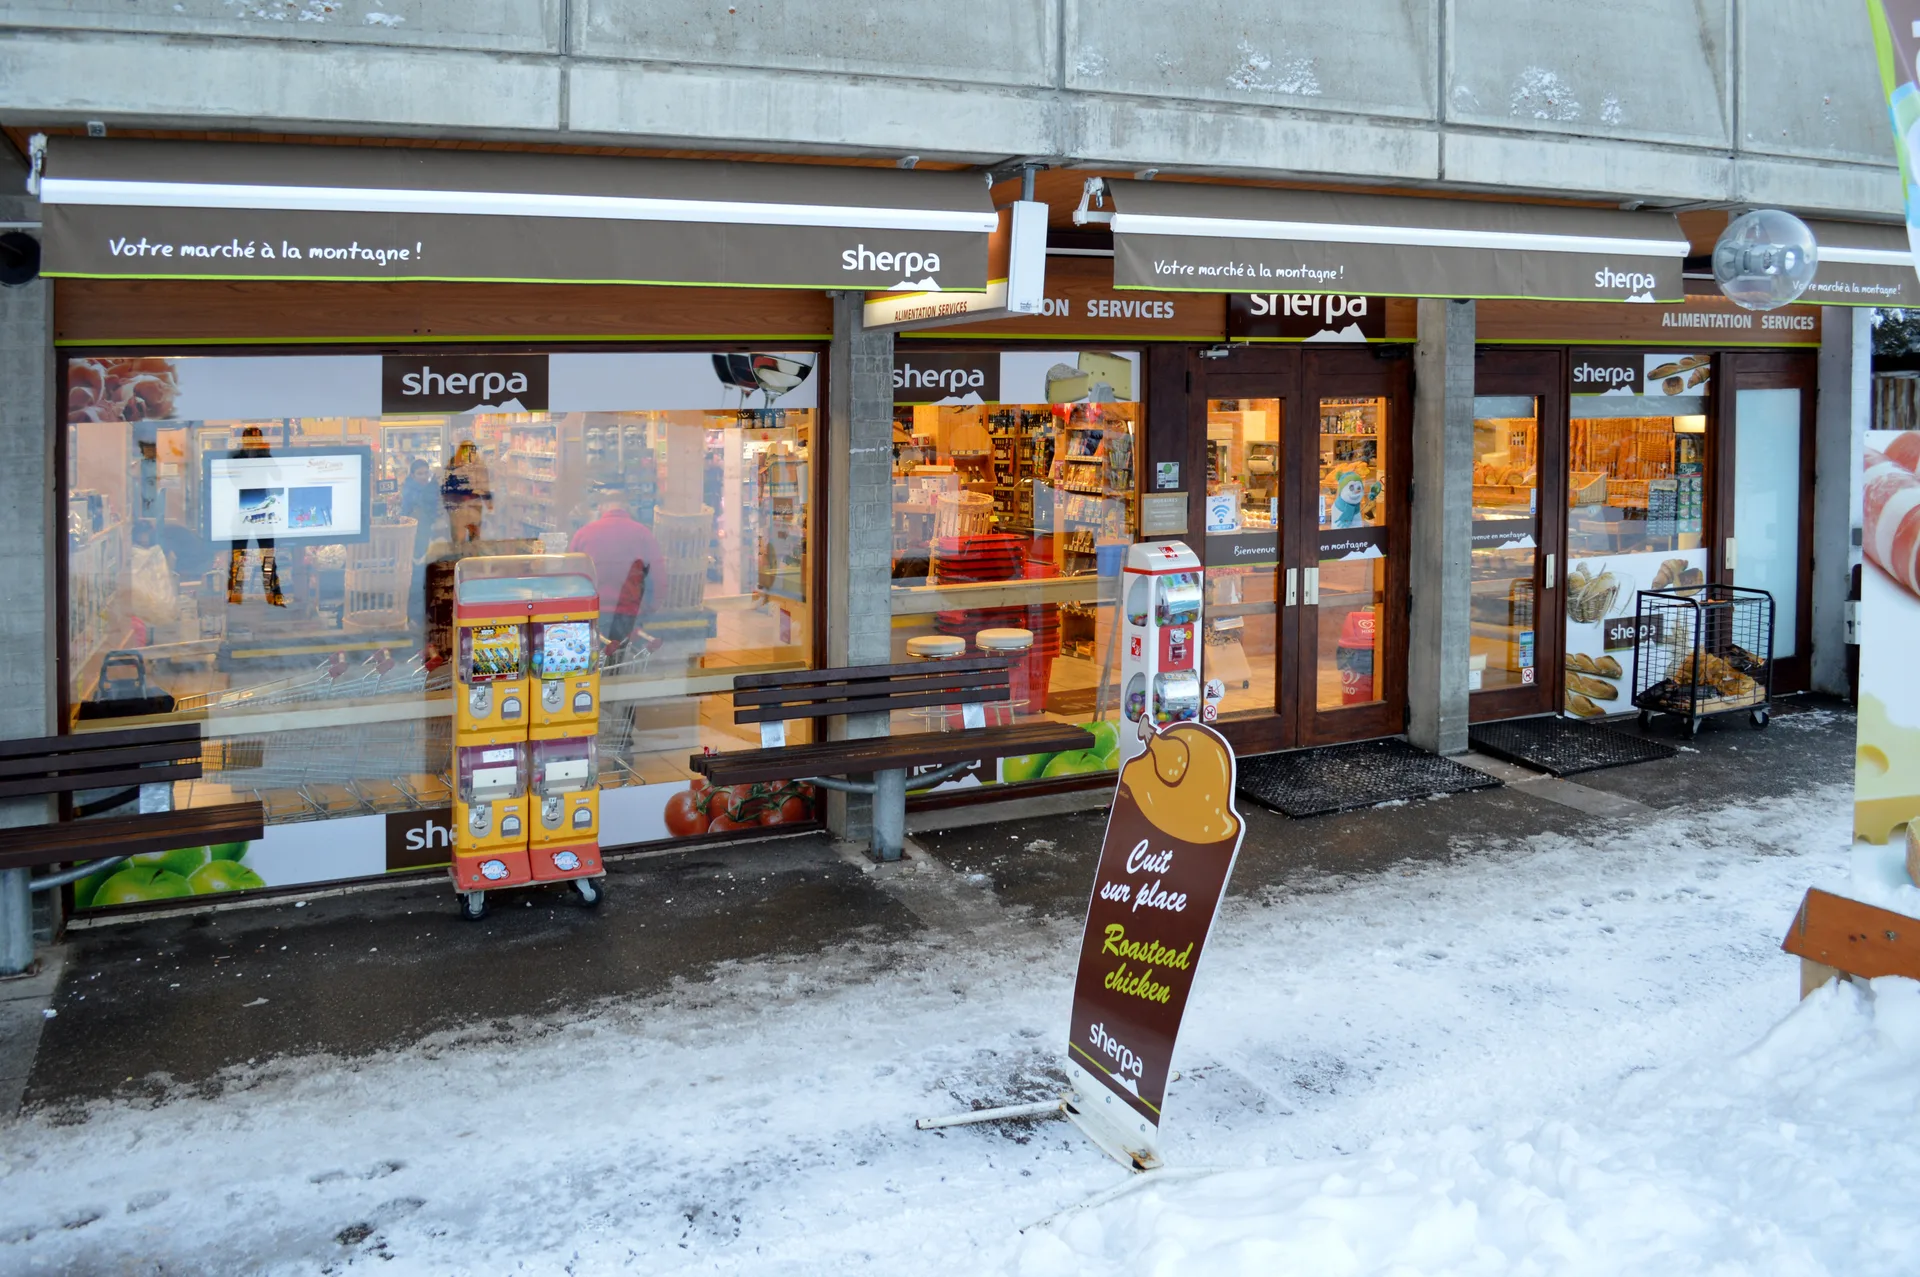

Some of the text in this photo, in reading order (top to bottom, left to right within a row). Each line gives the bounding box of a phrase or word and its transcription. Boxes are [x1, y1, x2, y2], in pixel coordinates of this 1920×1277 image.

[109, 237, 173, 257] Votre
[180, 239, 255, 258] marché
[261, 242, 275, 259] à
[282, 241, 302, 259] la
[309, 241, 410, 266] montagne
[842, 243, 940, 277] sherpa
[1154, 260, 1194, 276] Votre
[1198, 261, 1244, 277] marché
[1247, 264, 1256, 278] à
[1259, 263, 1272, 278] la
[1594, 266, 1656, 293] sherpa
[1817, 281, 1844, 293] marché
[1845, 283, 1851, 293] à
[1852, 282, 1860, 294] la
[894, 301, 968, 322] ALIMENTATION SERVICES
[1087, 299, 1175, 319] SERVICES
[1661, 312, 1815, 330] ALIMENTATION SERVICES
[402, 366, 528, 400] sherpa
[892, 363, 985, 393] sherpa
[1573, 362, 1635, 387] sherpa
[1233, 545, 1276, 557] Bienvenue
[1331, 540, 1369, 551] montagne
[1610, 623, 1656, 641] shepa
[1126, 839, 1174, 874] Cuit
[1100, 879, 1187, 913] sur place
[1102, 923, 1194, 970] Roastead
[1104, 962, 1171, 1004] chicken
[1089, 1022, 1143, 1078] sherpa
